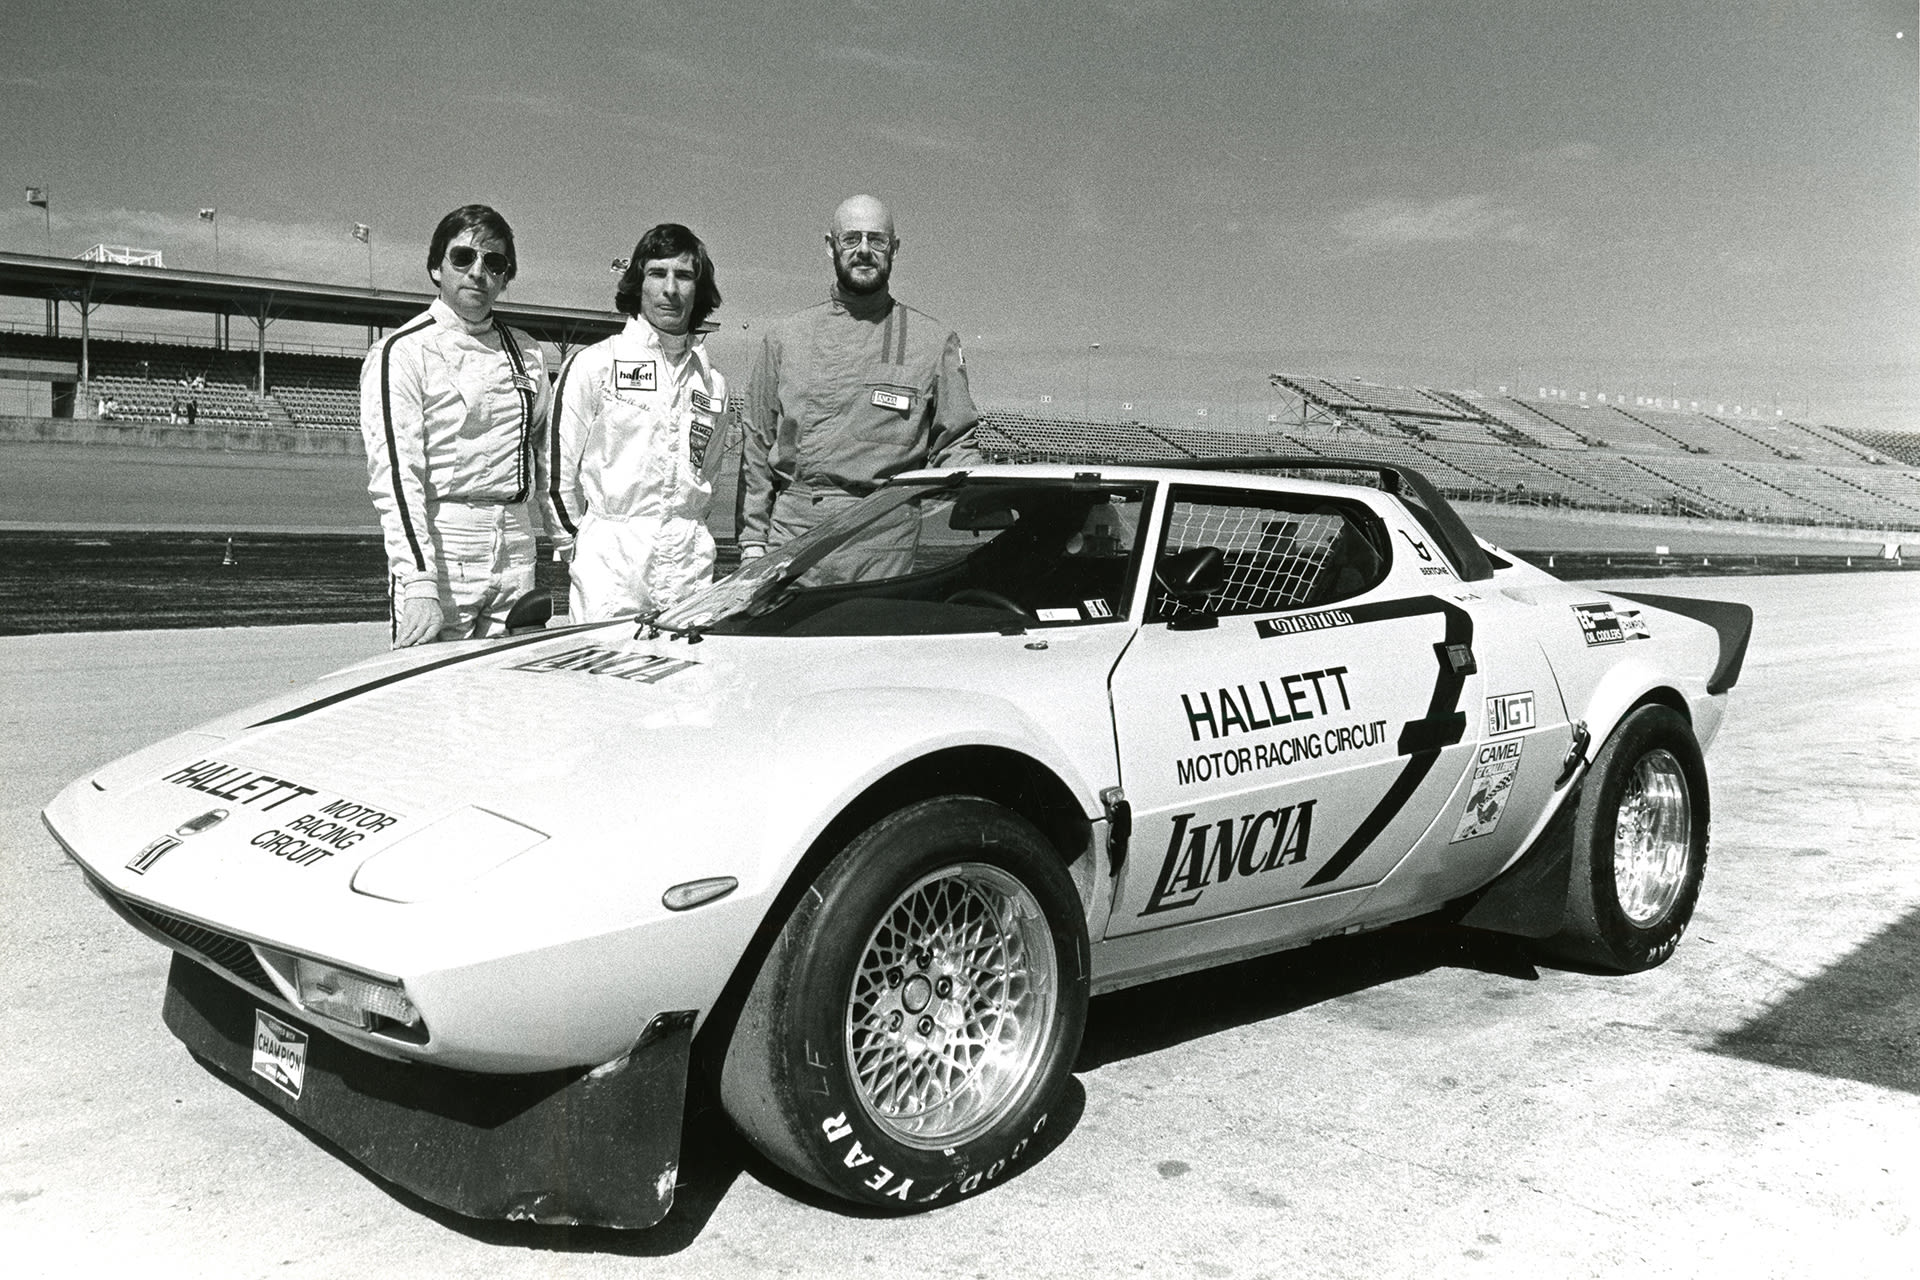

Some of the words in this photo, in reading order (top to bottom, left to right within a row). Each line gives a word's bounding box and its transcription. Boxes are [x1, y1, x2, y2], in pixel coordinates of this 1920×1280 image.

[1419, 566, 1450, 576] BERTONE
[1585, 631, 1597, 644] OIL
[1596, 628, 1623, 642] COOLERS
[504, 645, 702, 684] LANCIA
[1181, 666, 1350, 741] HALLETT
[1507, 697, 1532, 726] GT
[1177, 752, 1251, 785] MOTOR
[1256, 737, 1322, 770] RACING
[1326, 720, 1387, 756] CIRCUIT
[1479, 742, 1520, 765] CAMEL
[161, 759, 318, 812] HALLETT
[285, 814, 365, 850] RACING
[319, 799, 397, 833] MOTOR
[250, 829, 334, 867] CIRCUIT
[1138, 799, 1317, 917] LANCIA
[258, 1032, 302, 1072] CHAMPION
